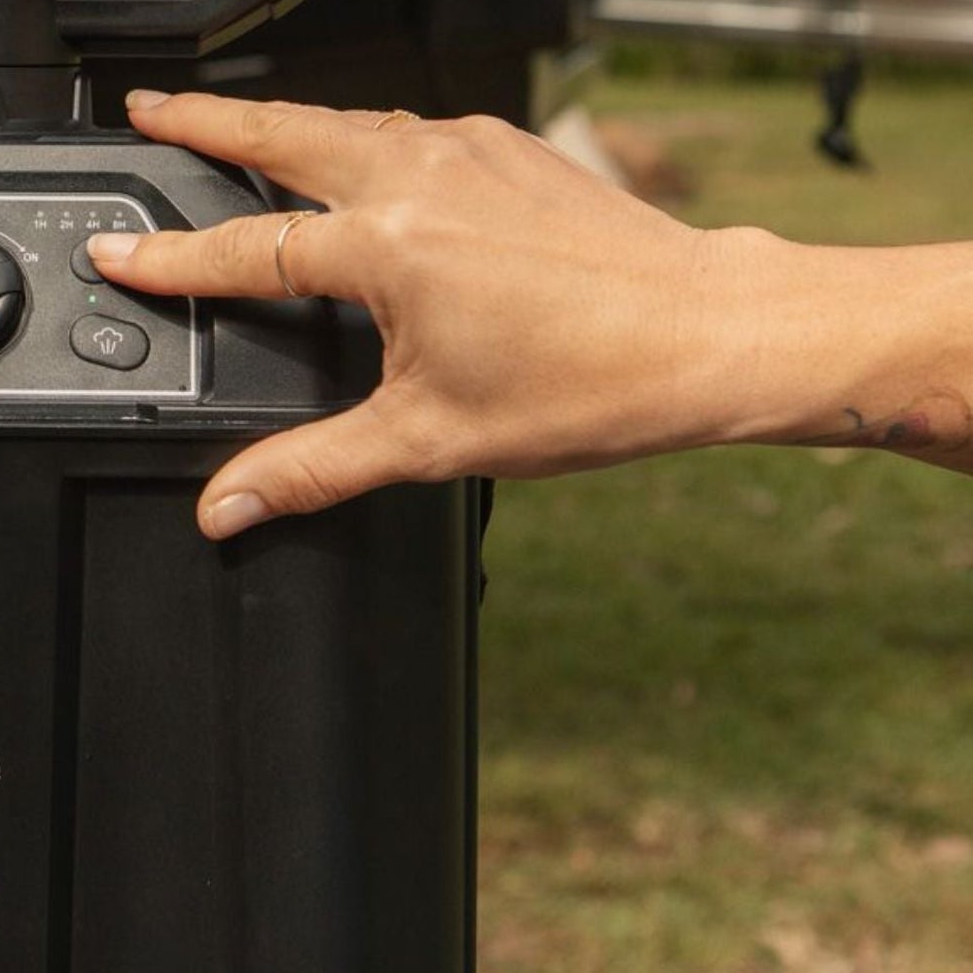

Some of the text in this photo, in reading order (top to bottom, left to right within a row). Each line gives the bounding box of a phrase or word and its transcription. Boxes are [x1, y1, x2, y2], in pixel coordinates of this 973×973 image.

[34, 219, 47, 229] 1H
[59, 219, 74, 229] 2H
[85, 219, 100, 229] 4H
[23, 252, 39, 263] ON
